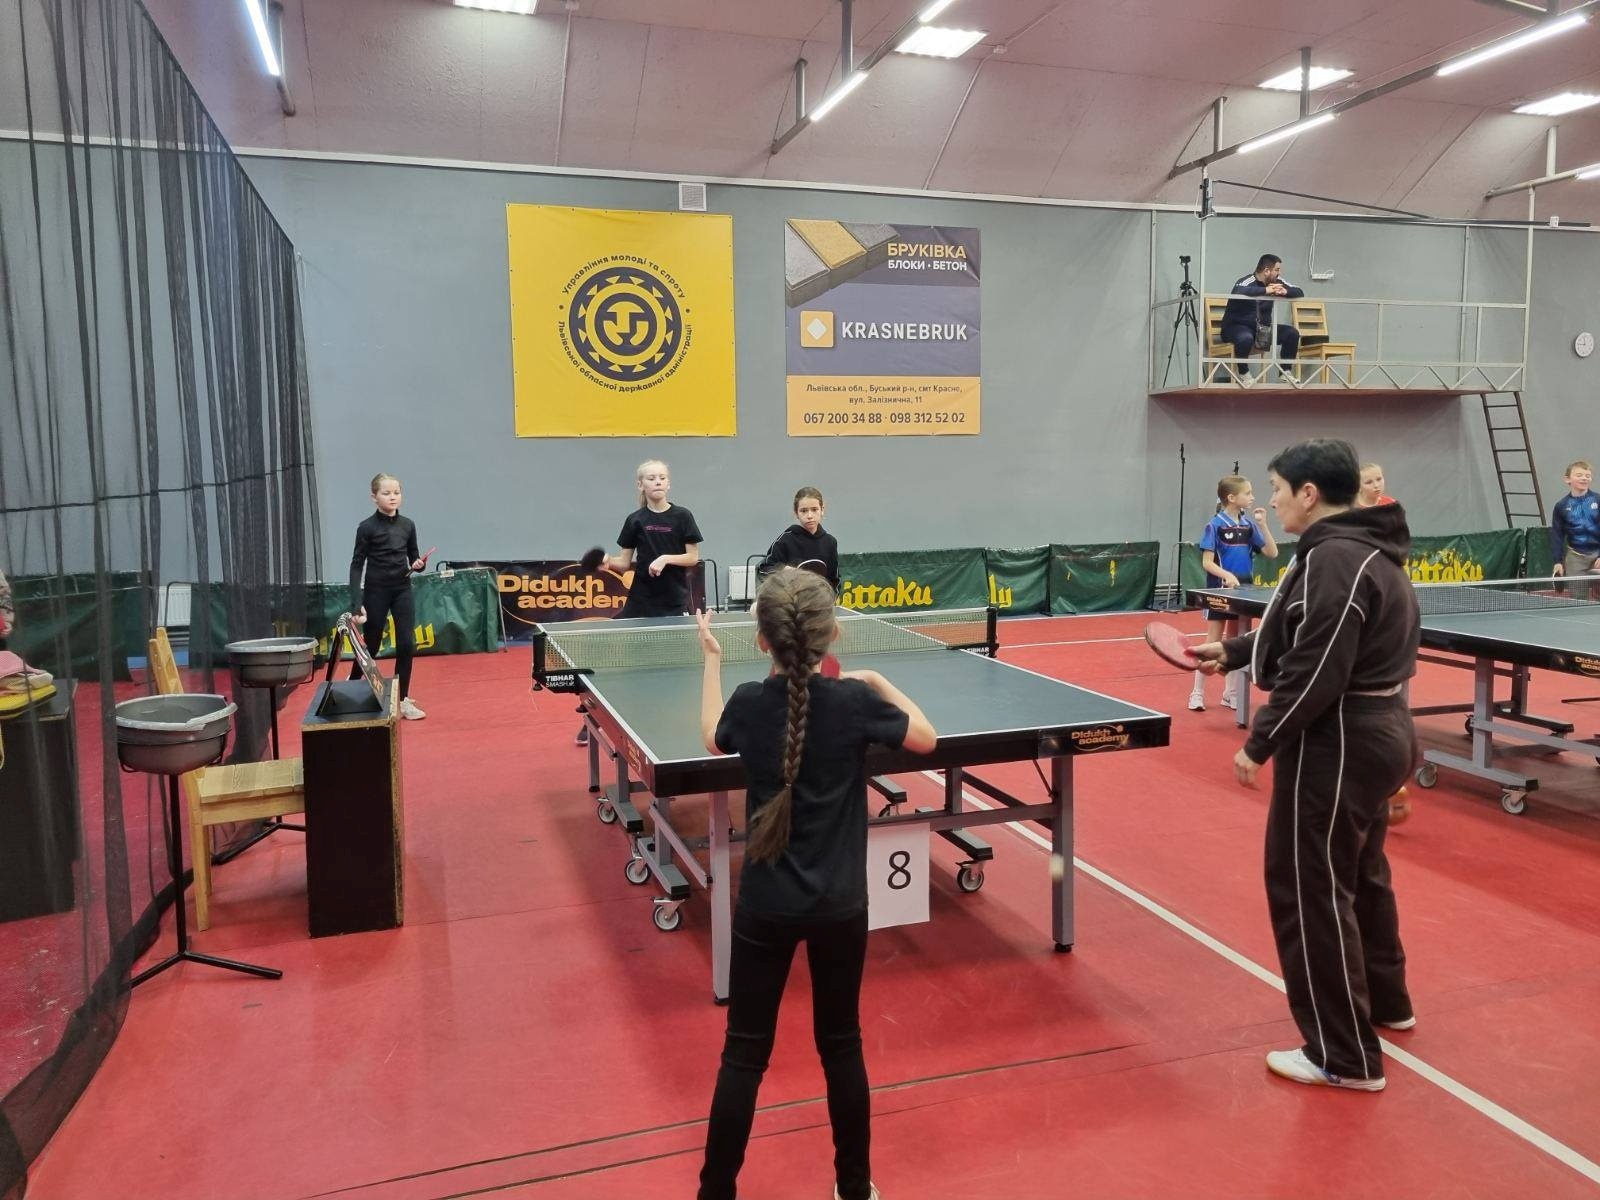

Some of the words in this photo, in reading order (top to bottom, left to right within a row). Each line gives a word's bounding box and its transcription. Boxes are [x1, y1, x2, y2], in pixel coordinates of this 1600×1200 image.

[887, 243, 967, 258] БРУКІВКА
[611, 254, 647, 265] молоді
[648, 261, 659, 271] та
[888, 260, 925, 270] БЛОКИ
[933, 261, 967, 271] БЕТОН
[841, 321, 968, 340] KRASNEBRUK
[579, 367, 618, 391] обласної
[618, 375, 665, 393] державної
[806, 384, 847, 392] Львівська
[869, 384, 901, 394] Буський
[803, 412, 825, 424] 067
[827, 412, 849, 424] 200
[851, 412, 866, 424] 34
[868, 412, 882, 424] 88
[889, 412, 911, 424] 098
[913, 412, 933, 424] 312
[935, 412, 949, 424] 52
[951, 412, 965, 424] 02
[497, 575, 605, 592] Didukh
[836, 576, 933, 609] ittaku
[517, 594, 628, 608] acade
[545, 674, 575, 682] TIBHAR
[887, 850, 912, 890] 8
